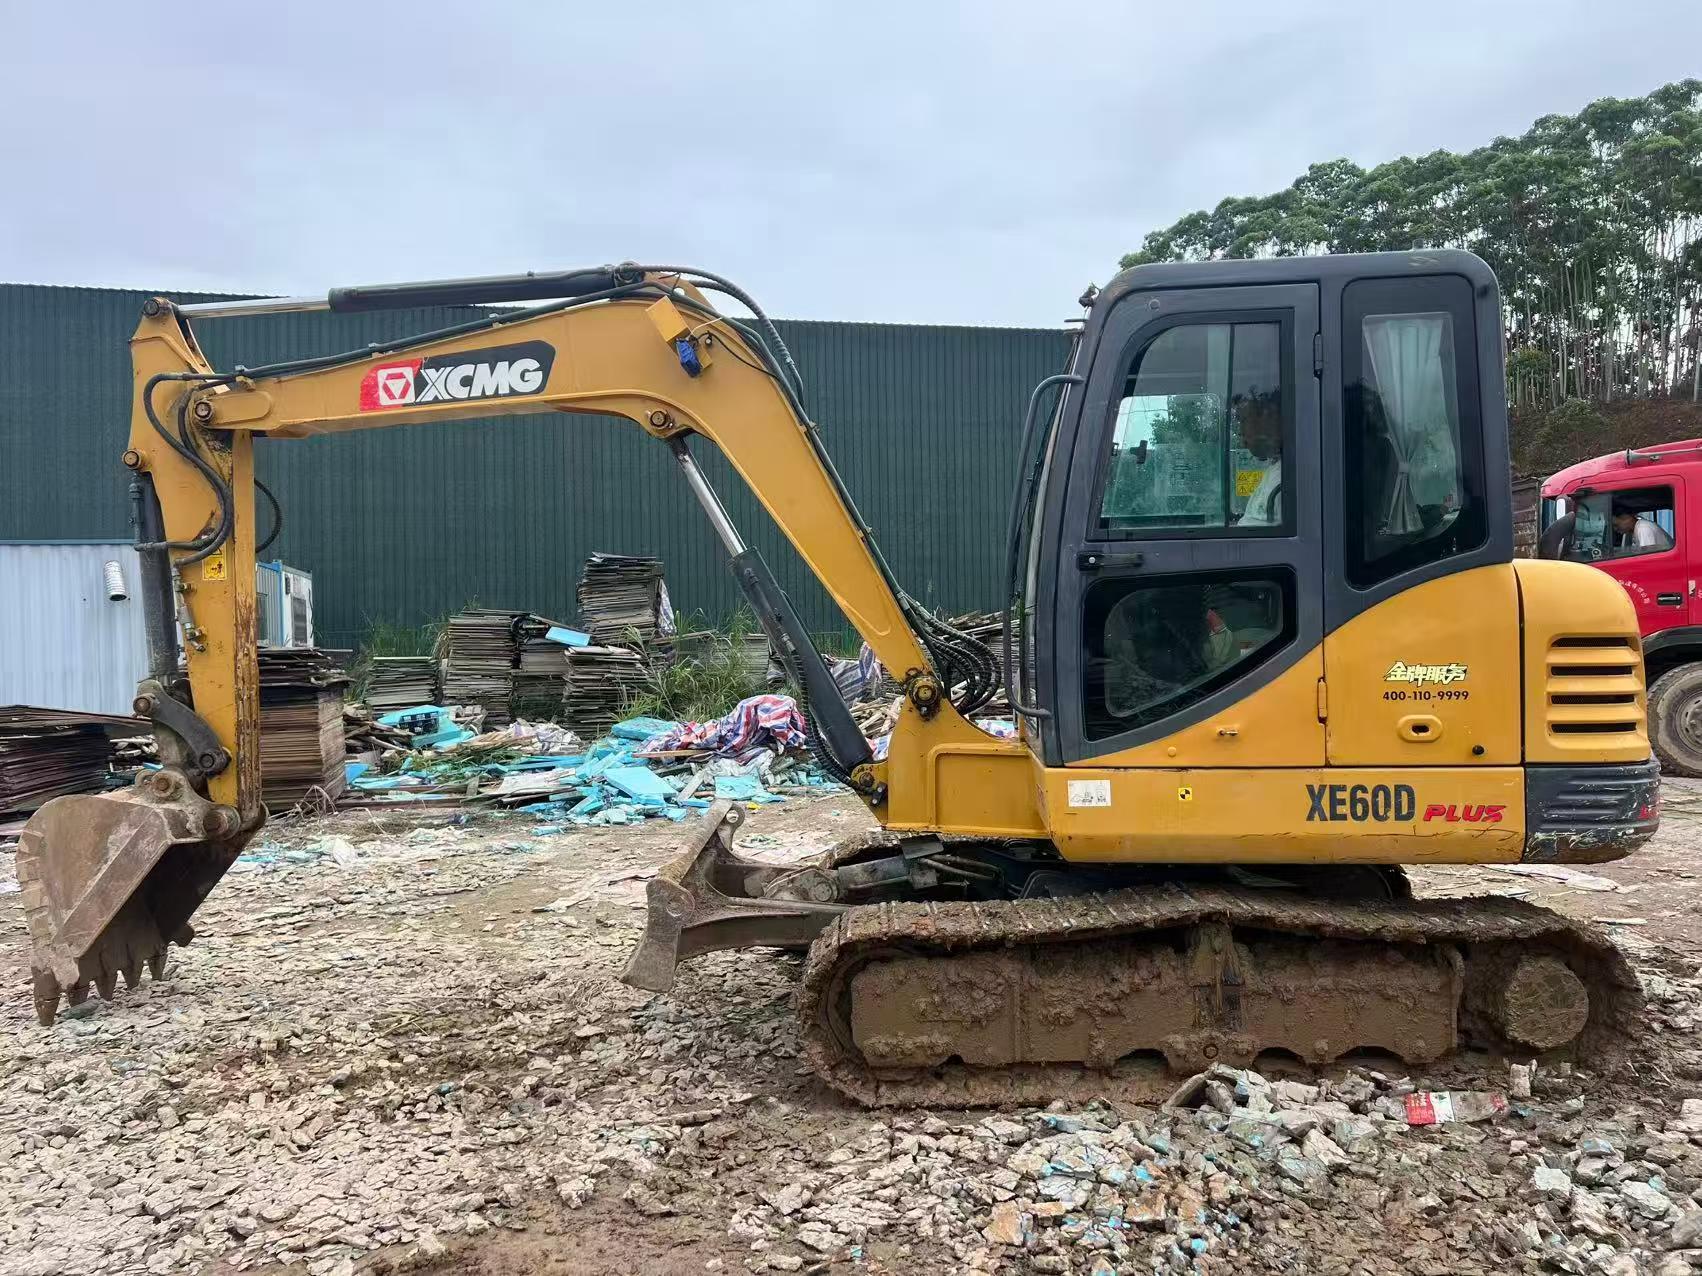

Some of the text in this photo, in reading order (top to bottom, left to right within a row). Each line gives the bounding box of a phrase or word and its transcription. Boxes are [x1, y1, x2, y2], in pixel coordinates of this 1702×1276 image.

[415, 358, 543, 402] XCMG
[1383, 661, 1467, 687] 金牌服务
[1383, 691, 1469, 701] 400-110-9999
[1306, 784, 1416, 822] XE60D
[1422, 804, 1507, 823] PLUS
